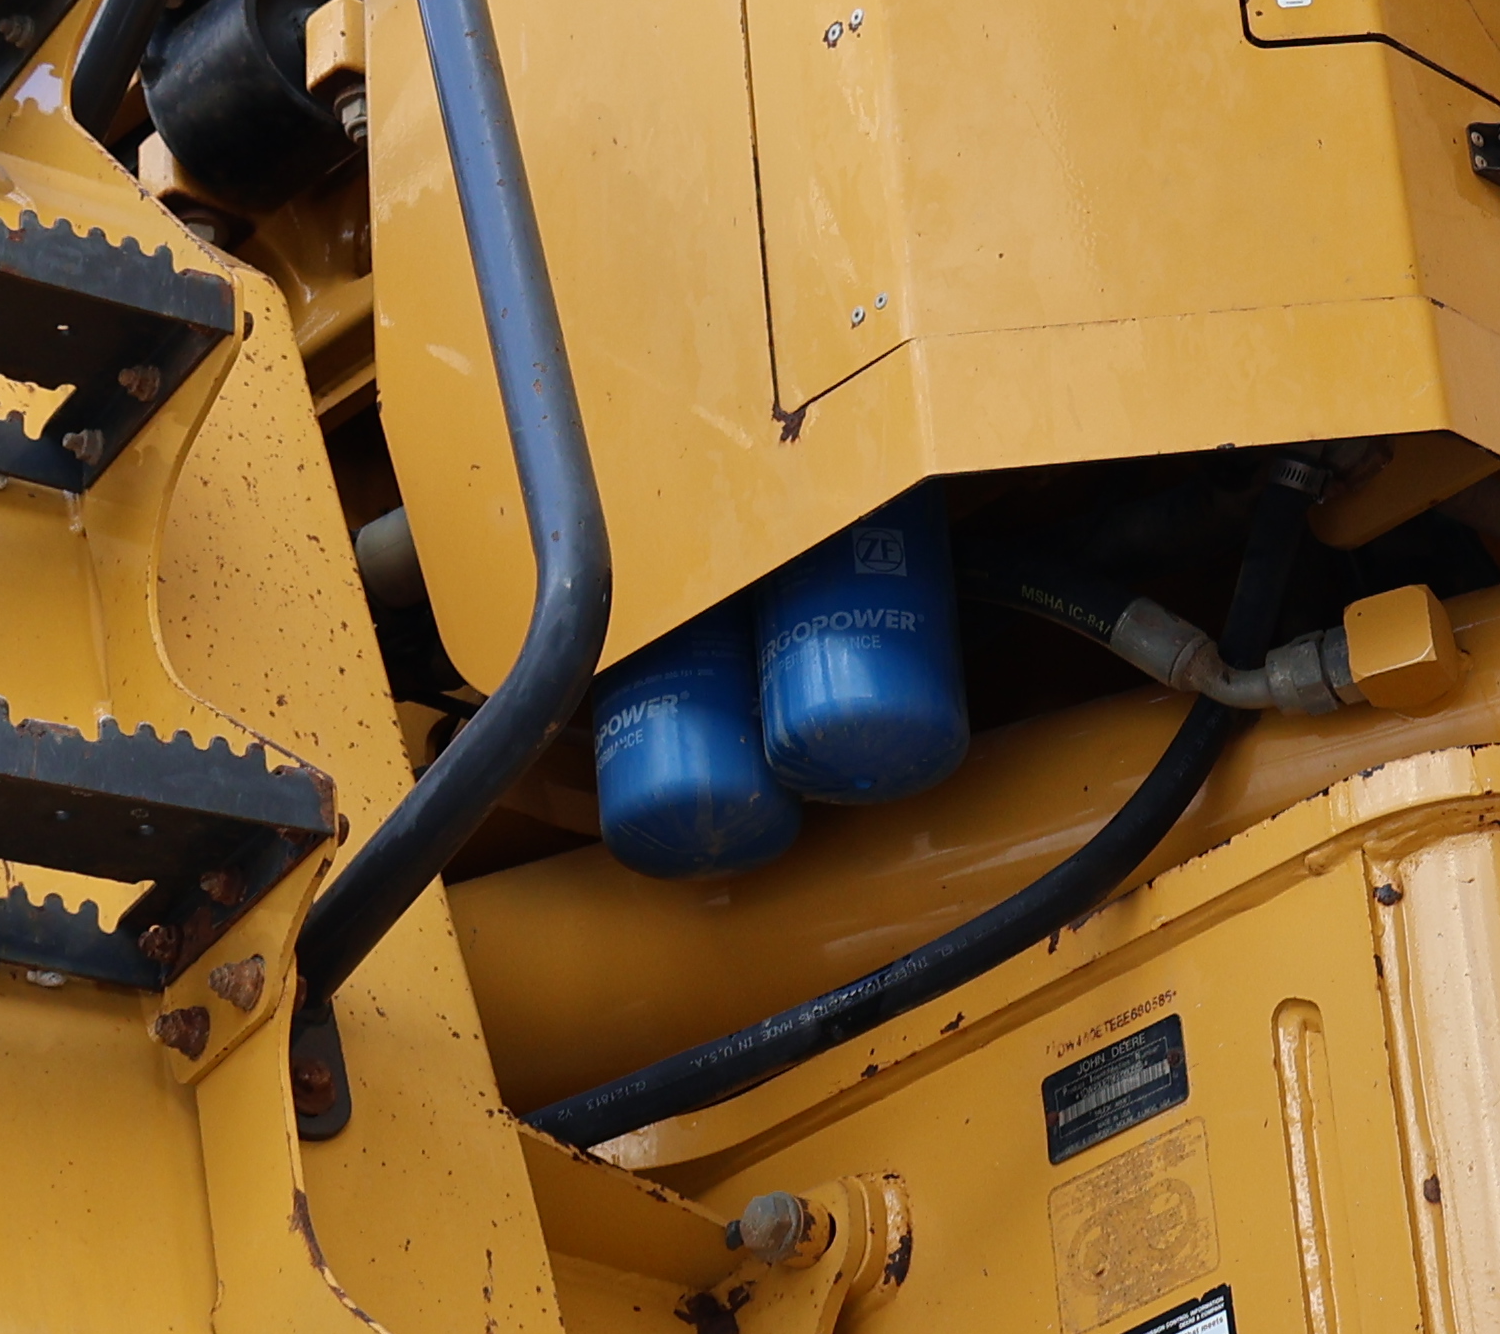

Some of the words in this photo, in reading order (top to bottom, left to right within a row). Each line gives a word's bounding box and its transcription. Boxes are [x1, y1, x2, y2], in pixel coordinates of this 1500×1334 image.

[1021, 583, 1064, 613] MSHA
[761, 1019, 794, 1042] MADE
[737, 1035, 754, 1052] IN
[1076, 1052, 1105, 1076] JOHN
[1110, 1031, 1146, 1059] DEERE
[689, 1044, 734, 1068] U.S.A.
[1200, 1315, 1224, 1333] meets
